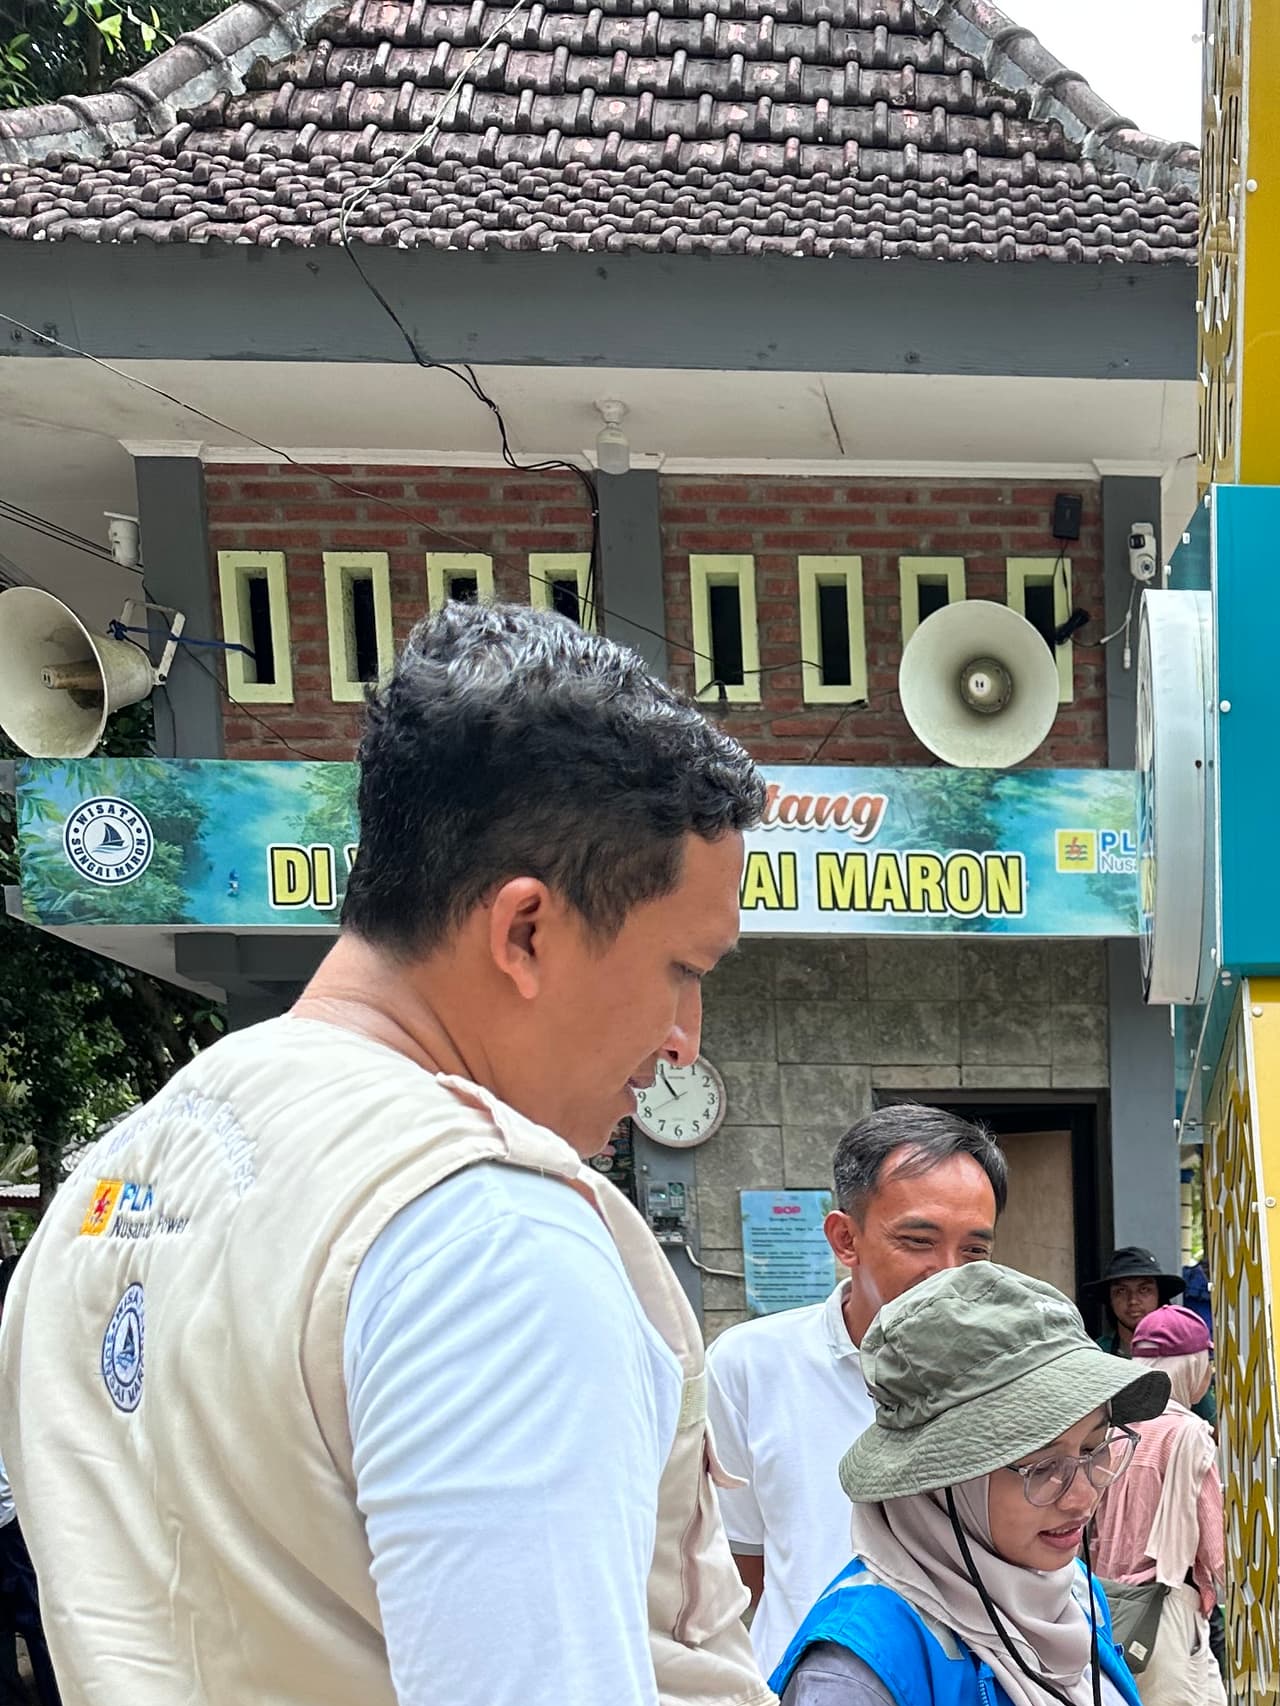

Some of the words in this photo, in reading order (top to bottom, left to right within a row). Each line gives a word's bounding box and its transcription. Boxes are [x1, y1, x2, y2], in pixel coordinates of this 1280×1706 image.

[76, 804, 137, 827] WISATA
[758, 783, 884, 838] tang
[1101, 831, 1137, 851] PL
[71, 838, 110, 878] SUNGAI
[114, 838, 146, 877] MARON
[1101, 855, 1137, 872] Nus
[270, 847, 332, 905] DI
[740, 852, 798, 910] AI
[816, 852, 1023, 913] MARON
[638, 1091, 647, 1104] 9
[702, 1075, 712, 1088] 2
[708, 1093, 716, 1105] 3
[644, 1106, 653, 1118] 8
[703, 1108, 711, 1120] 4
[658, 1119, 666, 1132] 7
[674, 1125, 683, 1137] 6
[692, 1120, 701, 1134] 5
[119, 1182, 154, 1211] PLN
